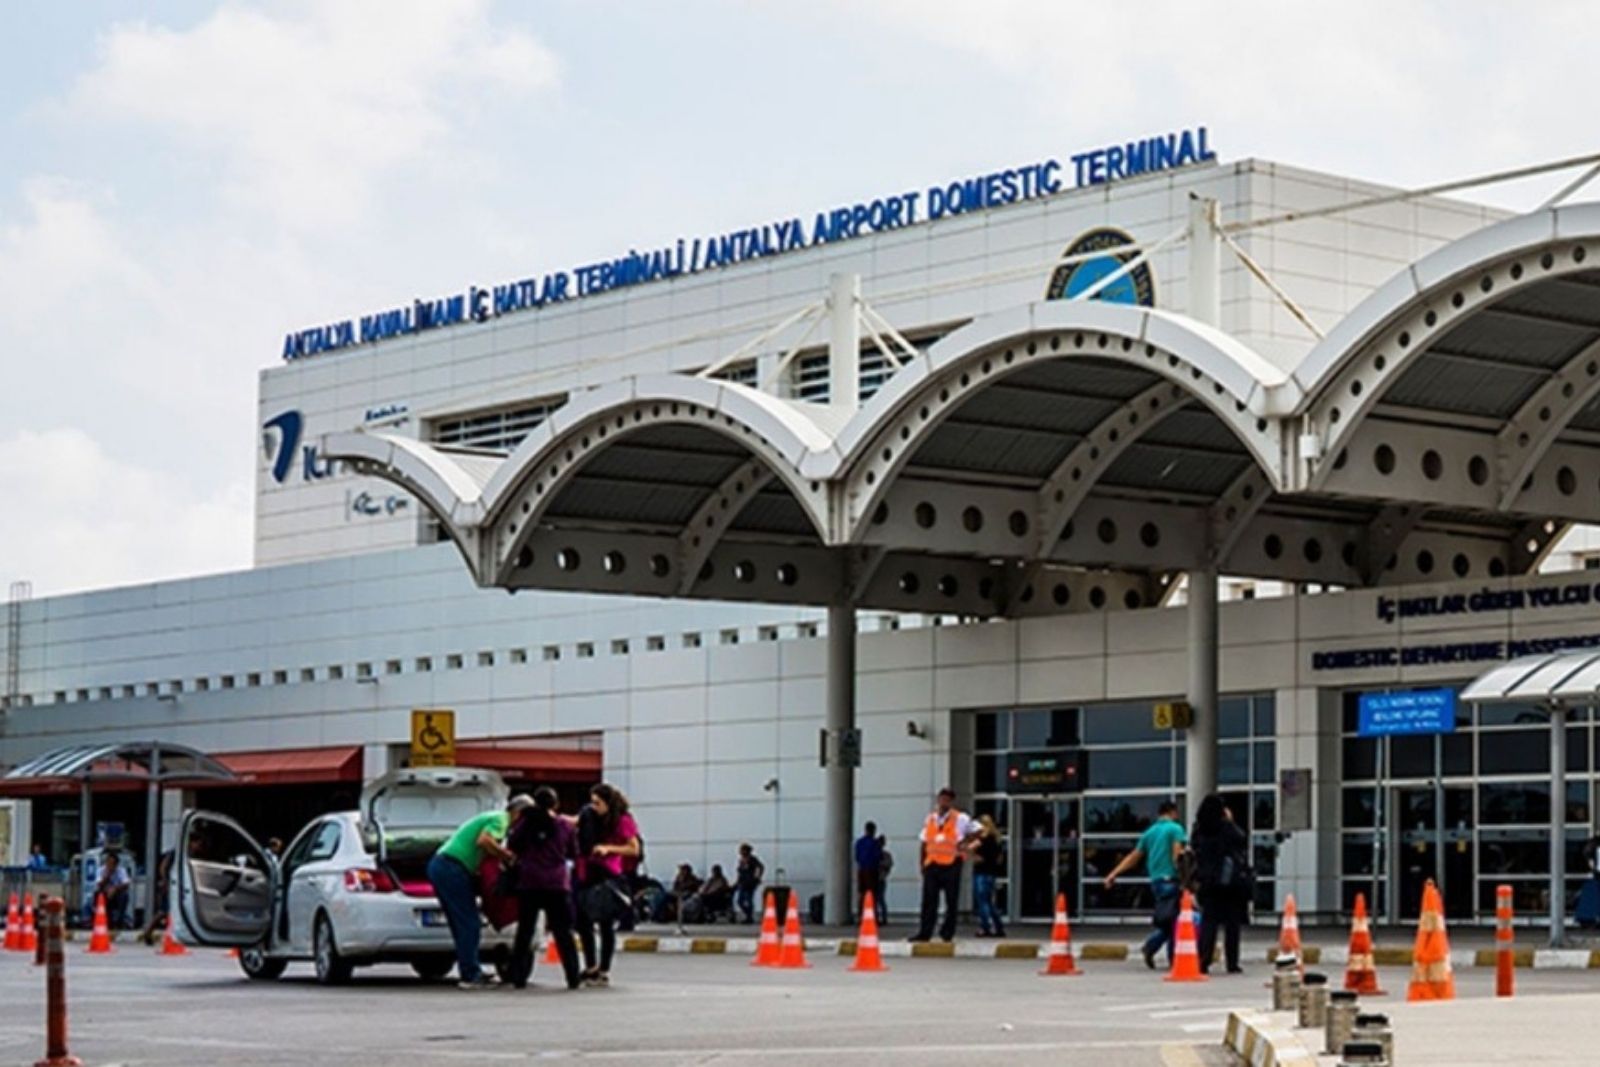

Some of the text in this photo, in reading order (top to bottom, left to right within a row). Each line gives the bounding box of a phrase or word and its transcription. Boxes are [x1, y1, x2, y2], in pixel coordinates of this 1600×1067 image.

[283, 320, 354, 359] ANTALYA
[469, 286, 490, 323] İÇ
[494, 271, 569, 317] HATLAR
[573, 239, 685, 298] TERMİNALİ
[704, 218, 802, 269] ANTALYA
[812, 191, 920, 245] AIRPORT
[928, 160, 1062, 220] DOMESTIC
[1070, 127, 1217, 185] TERMINAL
[1398, 593, 1467, 618] HATLAR
[1525, 584, 1592, 608] YOLCU
[1312, 647, 1398, 670] DOMESTIC
[1400, 641, 1507, 667] DEPARTURE
